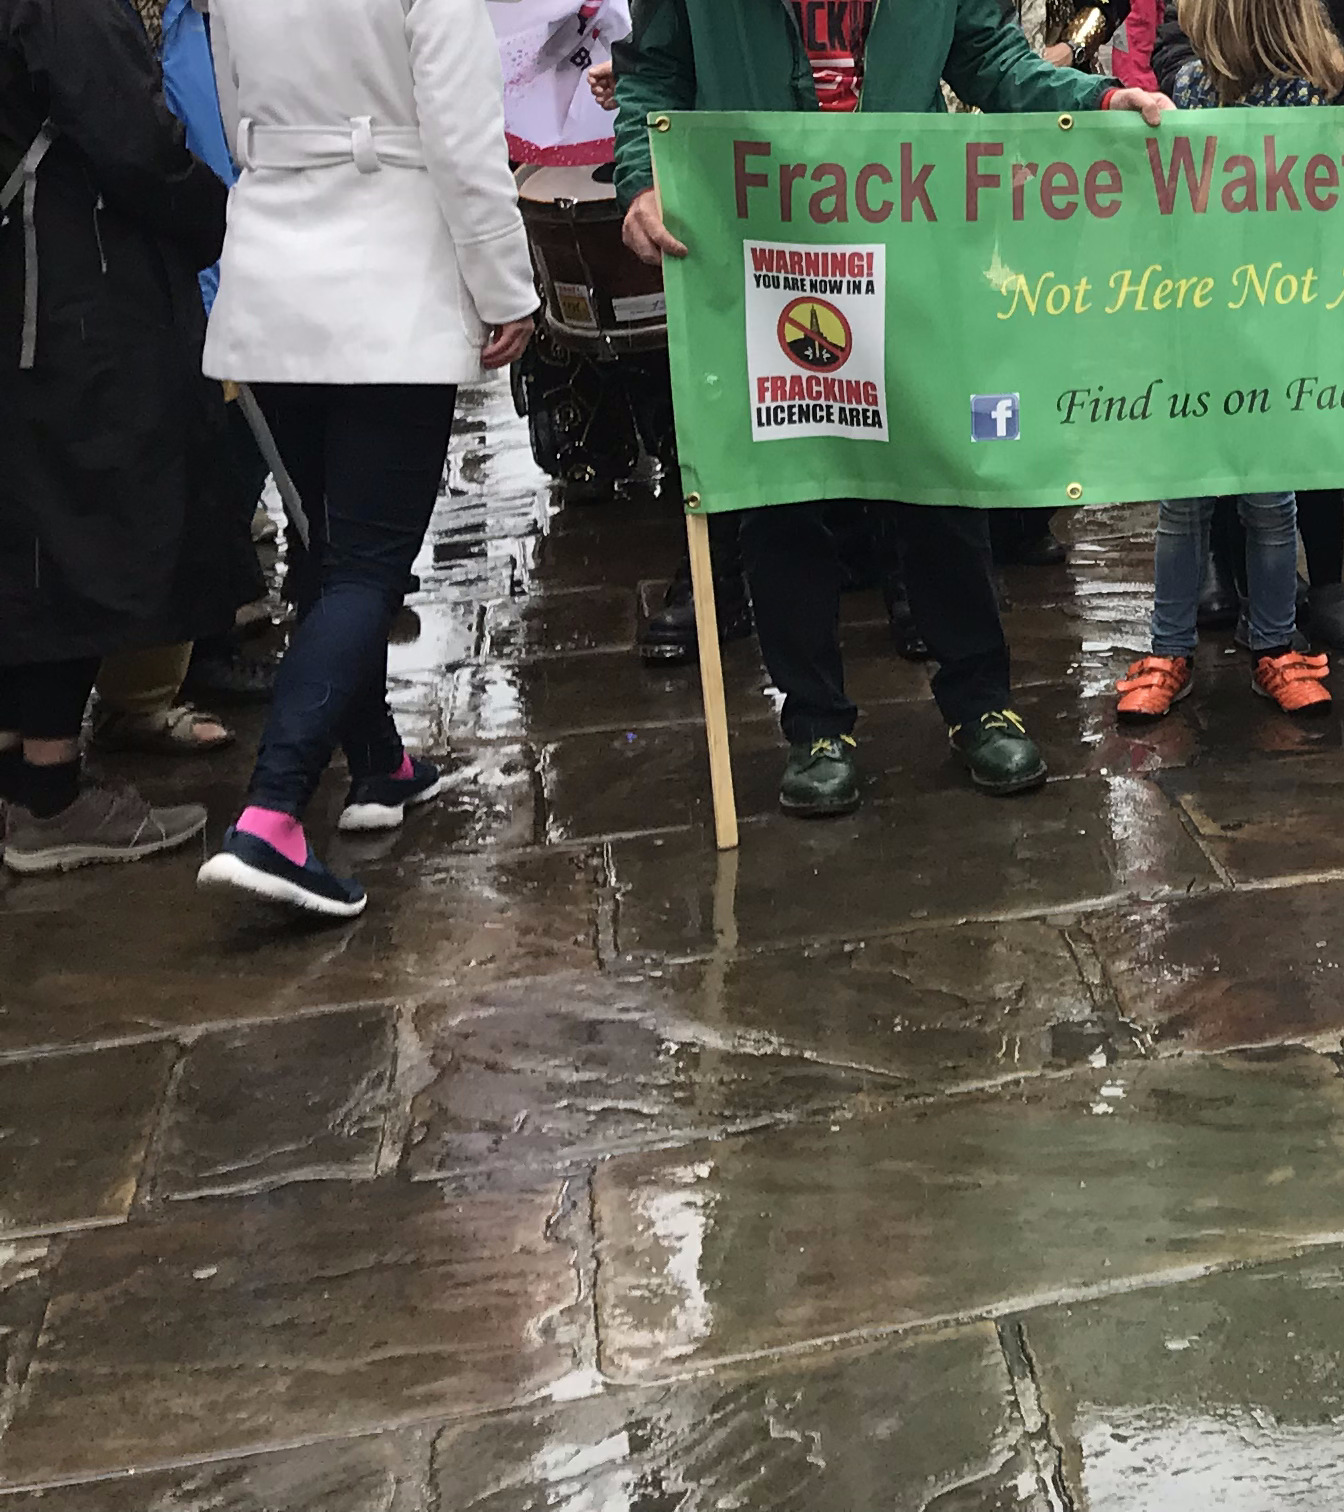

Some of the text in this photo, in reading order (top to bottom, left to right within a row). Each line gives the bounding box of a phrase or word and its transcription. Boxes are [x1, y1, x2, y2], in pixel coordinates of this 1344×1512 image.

[733, 141, 938, 225] Frack
[965, 141, 1123, 221] Free
[751, 248, 874, 278] WARNING!
[753, 274, 875, 295] YOU ARE NOW IN A
[997, 270, 1092, 320] Not
[1105, 264, 1214, 315] Here
[1228, 262, 1320, 310] Not
[757, 375, 879, 407] FRACKING
[1057, 379, 1163, 425] Find
[1168, 387, 1209, 418] us
[1222, 386, 1271, 416] on
[756, 404, 883, 429] LICENCE AREA
